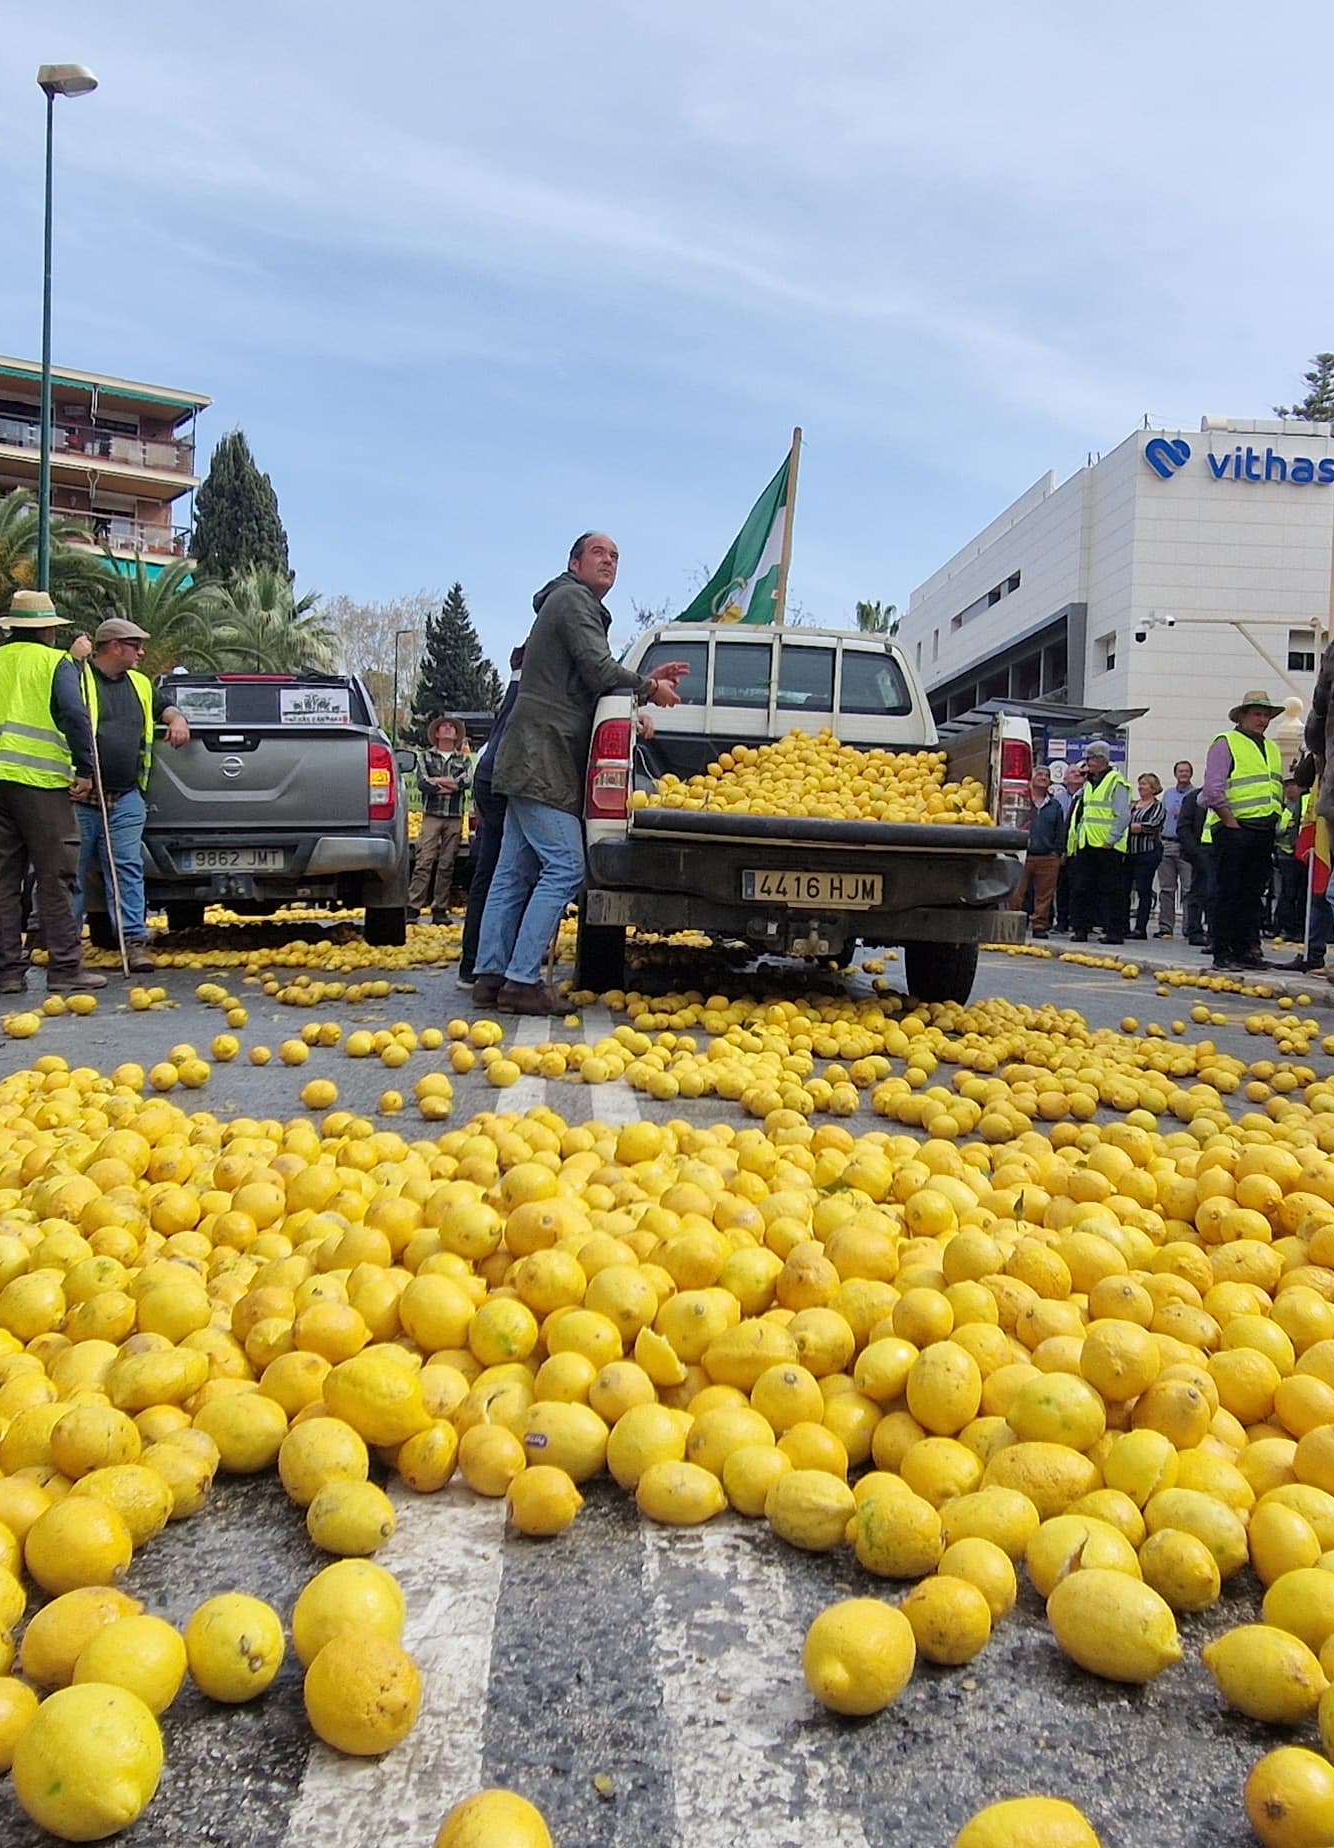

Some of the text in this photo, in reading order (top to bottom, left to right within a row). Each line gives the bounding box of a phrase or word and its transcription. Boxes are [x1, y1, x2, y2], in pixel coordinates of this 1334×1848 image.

[195, 850, 279, 867] 9862 JMT
[760, 874, 875, 901] 4416 HJM
